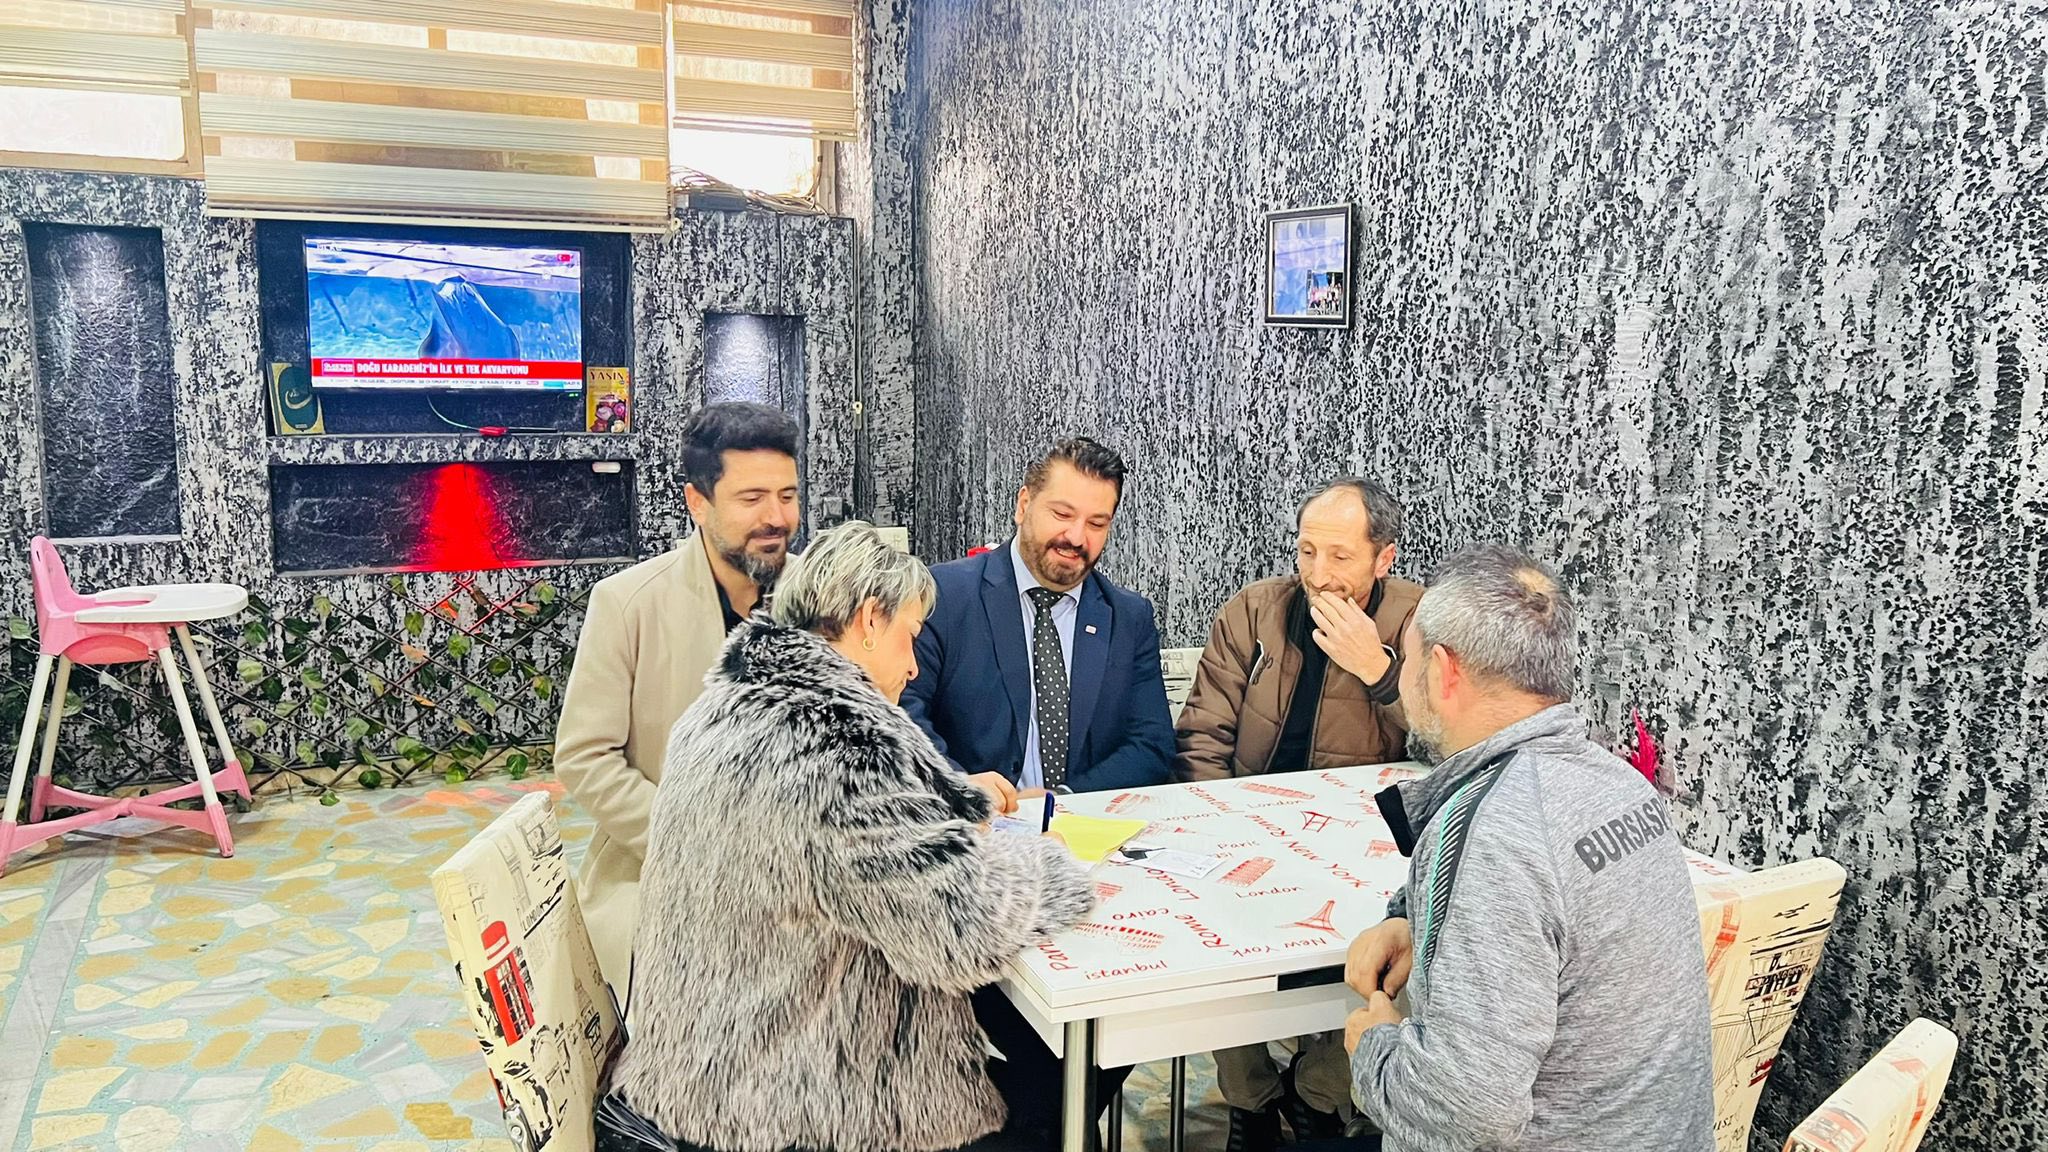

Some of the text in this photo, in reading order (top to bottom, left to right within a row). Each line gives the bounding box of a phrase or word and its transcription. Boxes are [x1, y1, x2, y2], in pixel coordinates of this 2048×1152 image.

[356, 361, 380, 373] DOĞU
[454, 364, 464, 374] VE
[466, 364, 480, 374] TEK
[481, 365, 529, 375] AKVARYUMU
[1247, 799, 1304, 809] London
[1161, 811, 1221, 822] London
[1244, 814, 1293, 838] Rome
[1217, 840, 1261, 850] Paris
[1280, 841, 1373, 888] New York
[1144, 866, 1200, 901] Londo
[1235, 885, 1305, 899] London
[1174, 914, 1229, 949] Rome
[1037, 941, 1079, 971] Pari
[1232, 937, 1327, 957] New York
